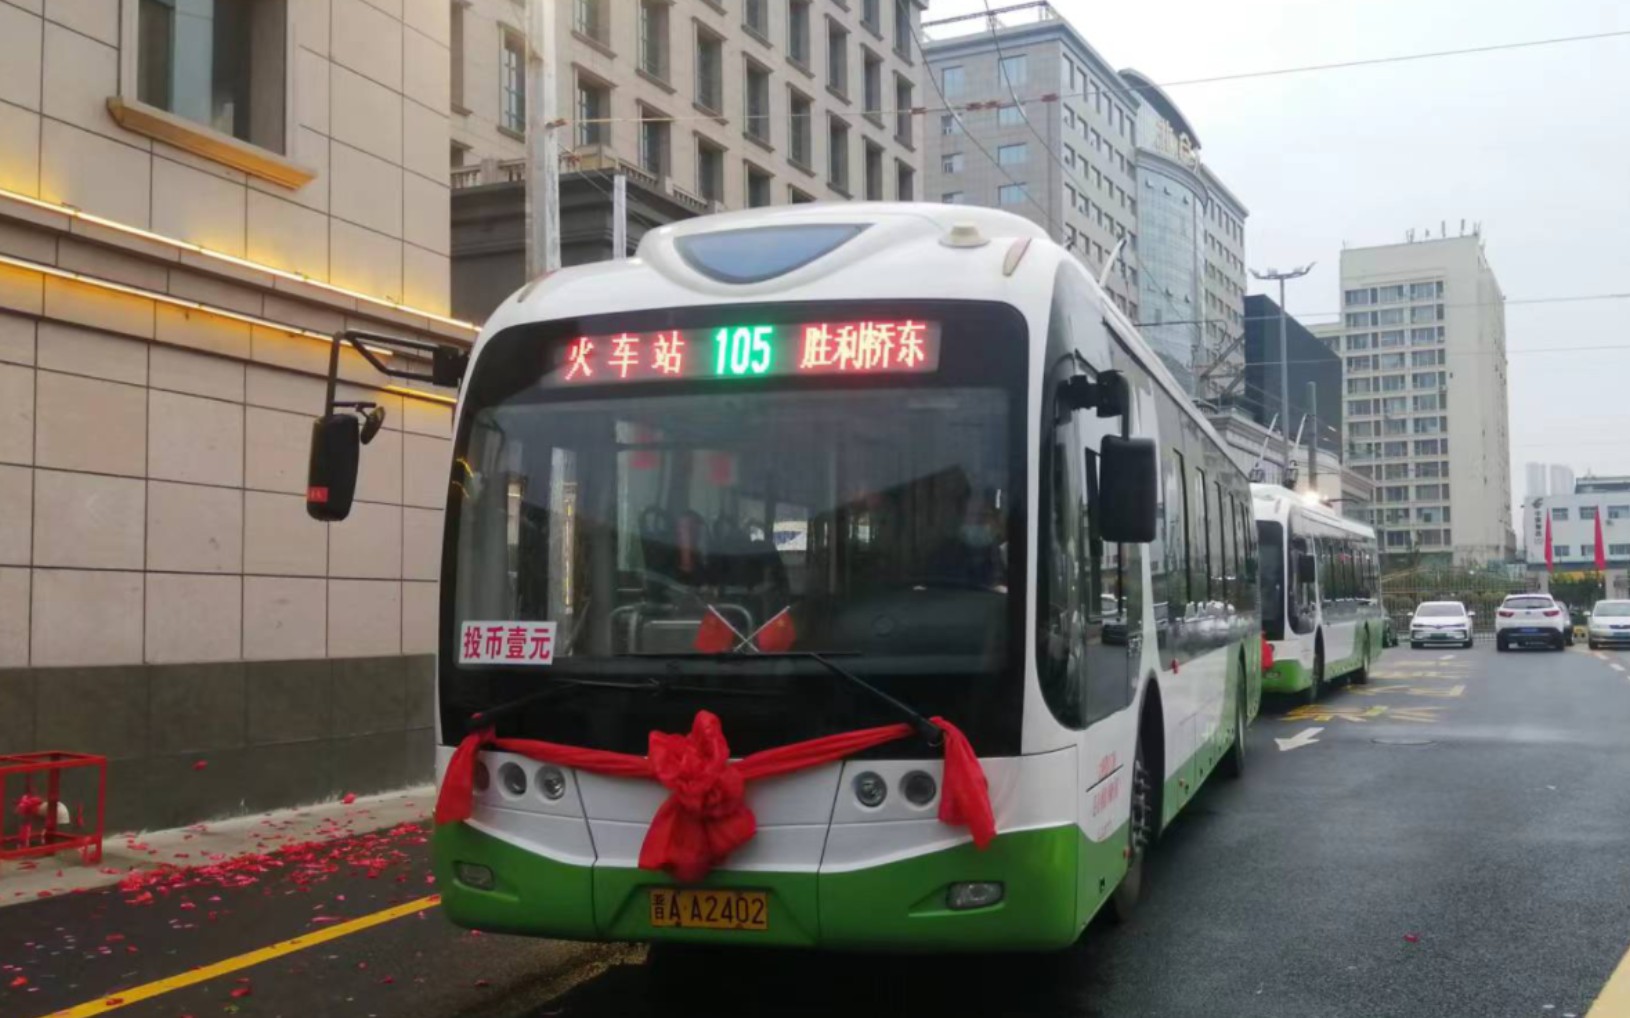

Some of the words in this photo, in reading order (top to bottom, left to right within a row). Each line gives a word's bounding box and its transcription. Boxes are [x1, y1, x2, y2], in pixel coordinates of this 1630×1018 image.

[565, 332, 685, 380] 火车站
[715, 326, 773, 374] 105
[800, 320, 926, 369] 胜利桥东
[463, 625, 551, 660] 投币壹元
